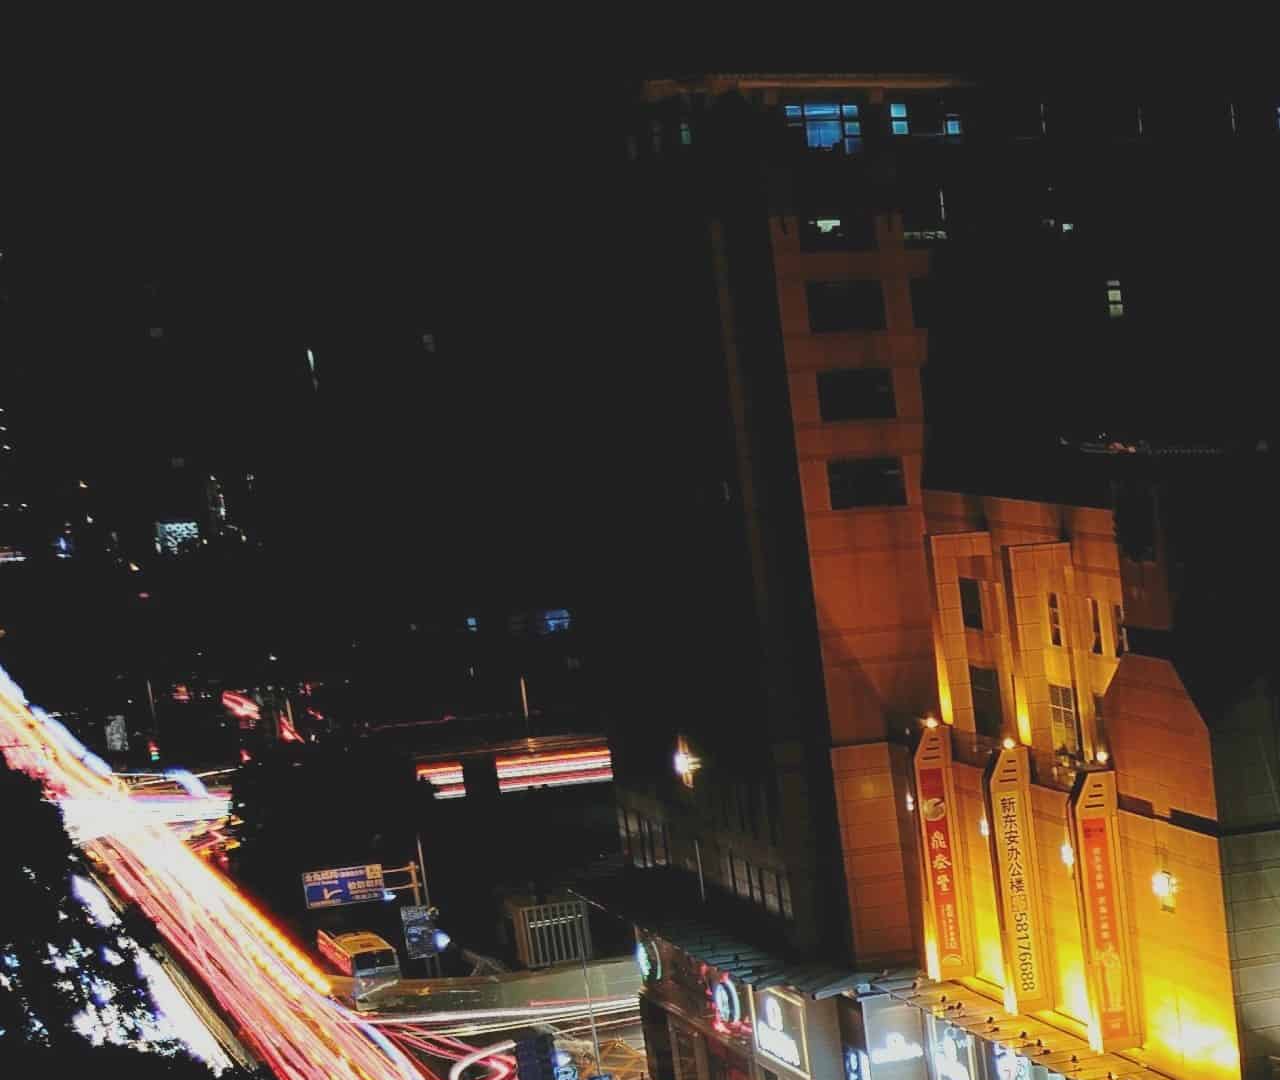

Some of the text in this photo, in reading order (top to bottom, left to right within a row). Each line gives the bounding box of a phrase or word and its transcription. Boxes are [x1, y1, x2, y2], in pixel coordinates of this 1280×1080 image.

[1000, 796, 1036, 992] 新东安办公楼 58176688
